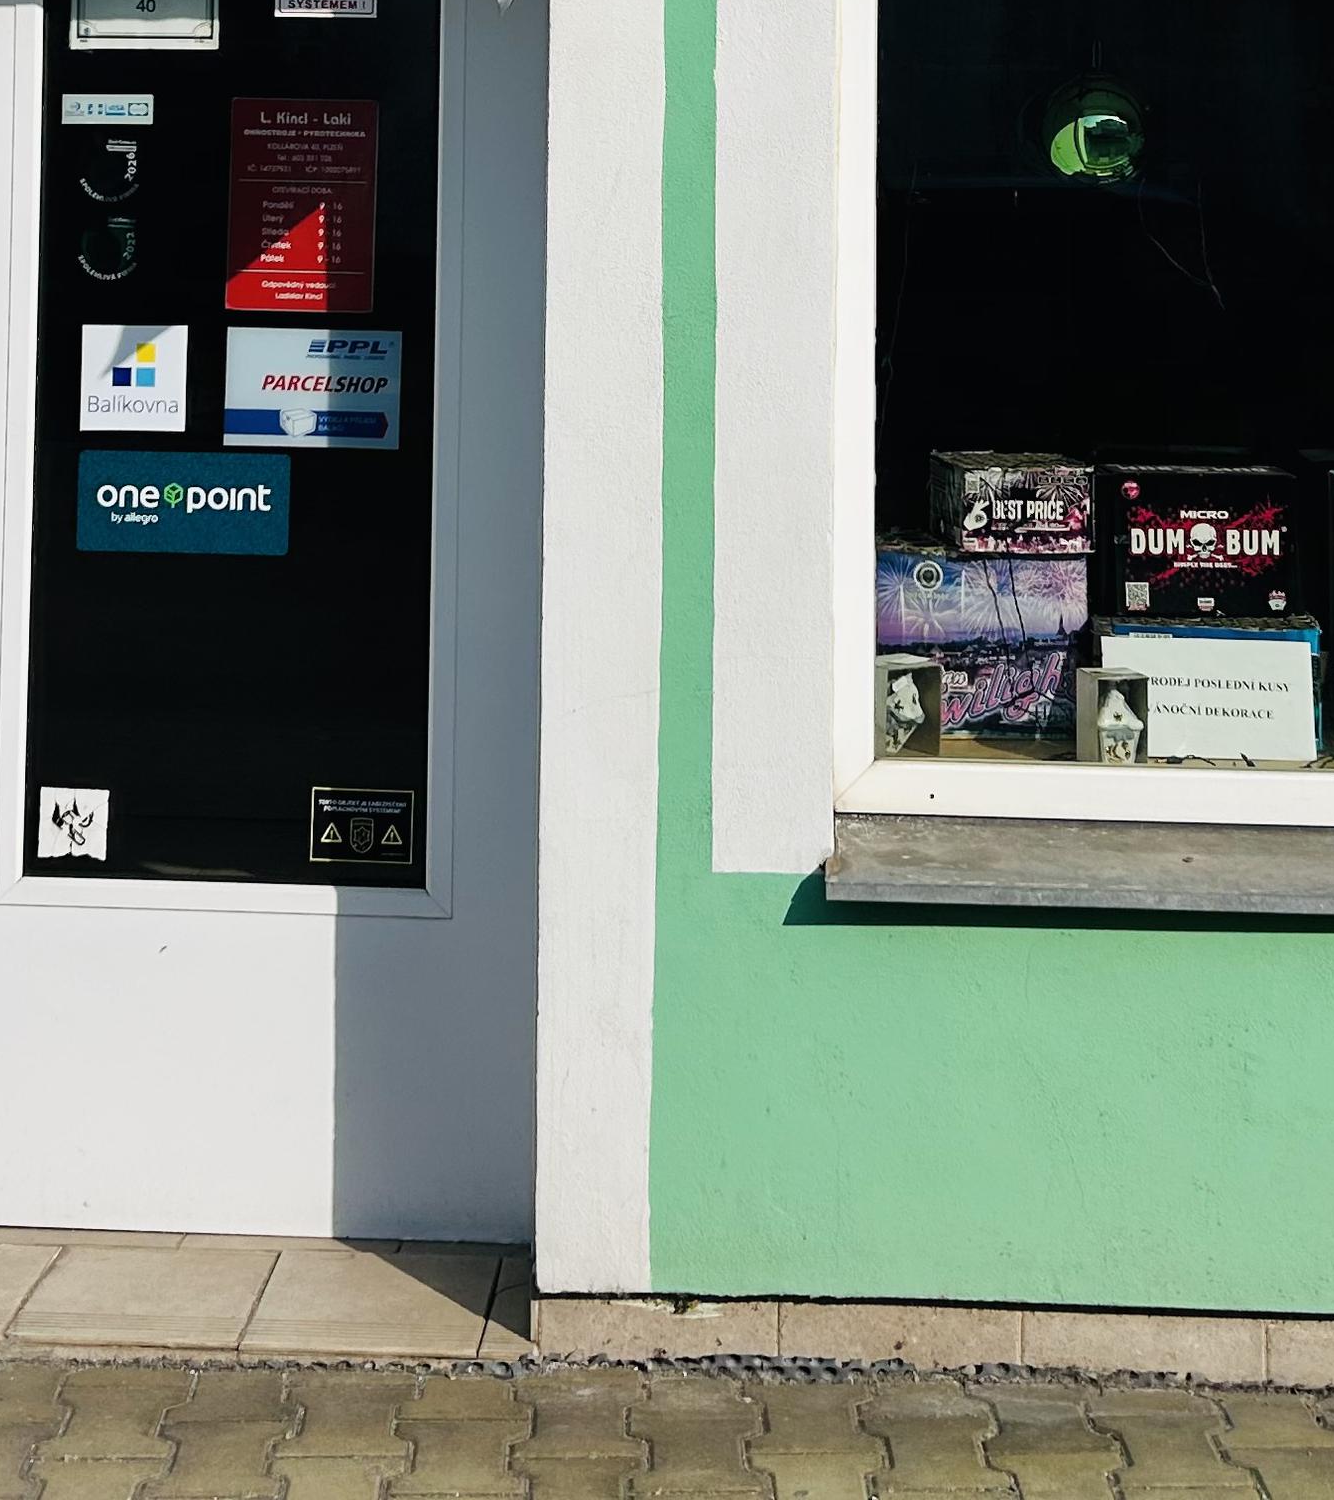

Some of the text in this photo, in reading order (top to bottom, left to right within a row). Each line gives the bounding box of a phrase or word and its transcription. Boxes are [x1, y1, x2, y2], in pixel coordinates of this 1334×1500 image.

[135, 0, 156, 13] 40
[260, 111, 272, 124] L.
[276, 111, 308, 125] Kincl
[323, 112, 352, 125] Laki
[124, 152, 138, 182] 2026
[332, 202, 343, 211] 16
[318, 214, 325, 224] 9
[331, 215, 343, 224] 16
[317, 228, 325, 237] 9
[331, 229, 342, 238] 16
[317, 241, 324, 251] 9
[331, 242, 342, 251] 16
[316, 254, 324, 264] 9
[331, 255, 342, 265] 16
[327, 339, 388, 355] PPL
[261, 374, 388, 394] PARCELSHOP
[87, 395, 179, 414] Balíkovna
[97, 484, 271, 513] one point
[992, 499, 1064, 521] BEST PRICE
[1179, 510, 1229, 520] MICRO
[111, 512, 159, 525] by allegro
[1130, 528, 1281, 557] DUM BUM
[1148, 676, 1192, 687] RODEJ
[1258, 681, 1291, 693] KUSY
[1148, 701, 1275, 720] ÁNOČNÍ DEKORACE
